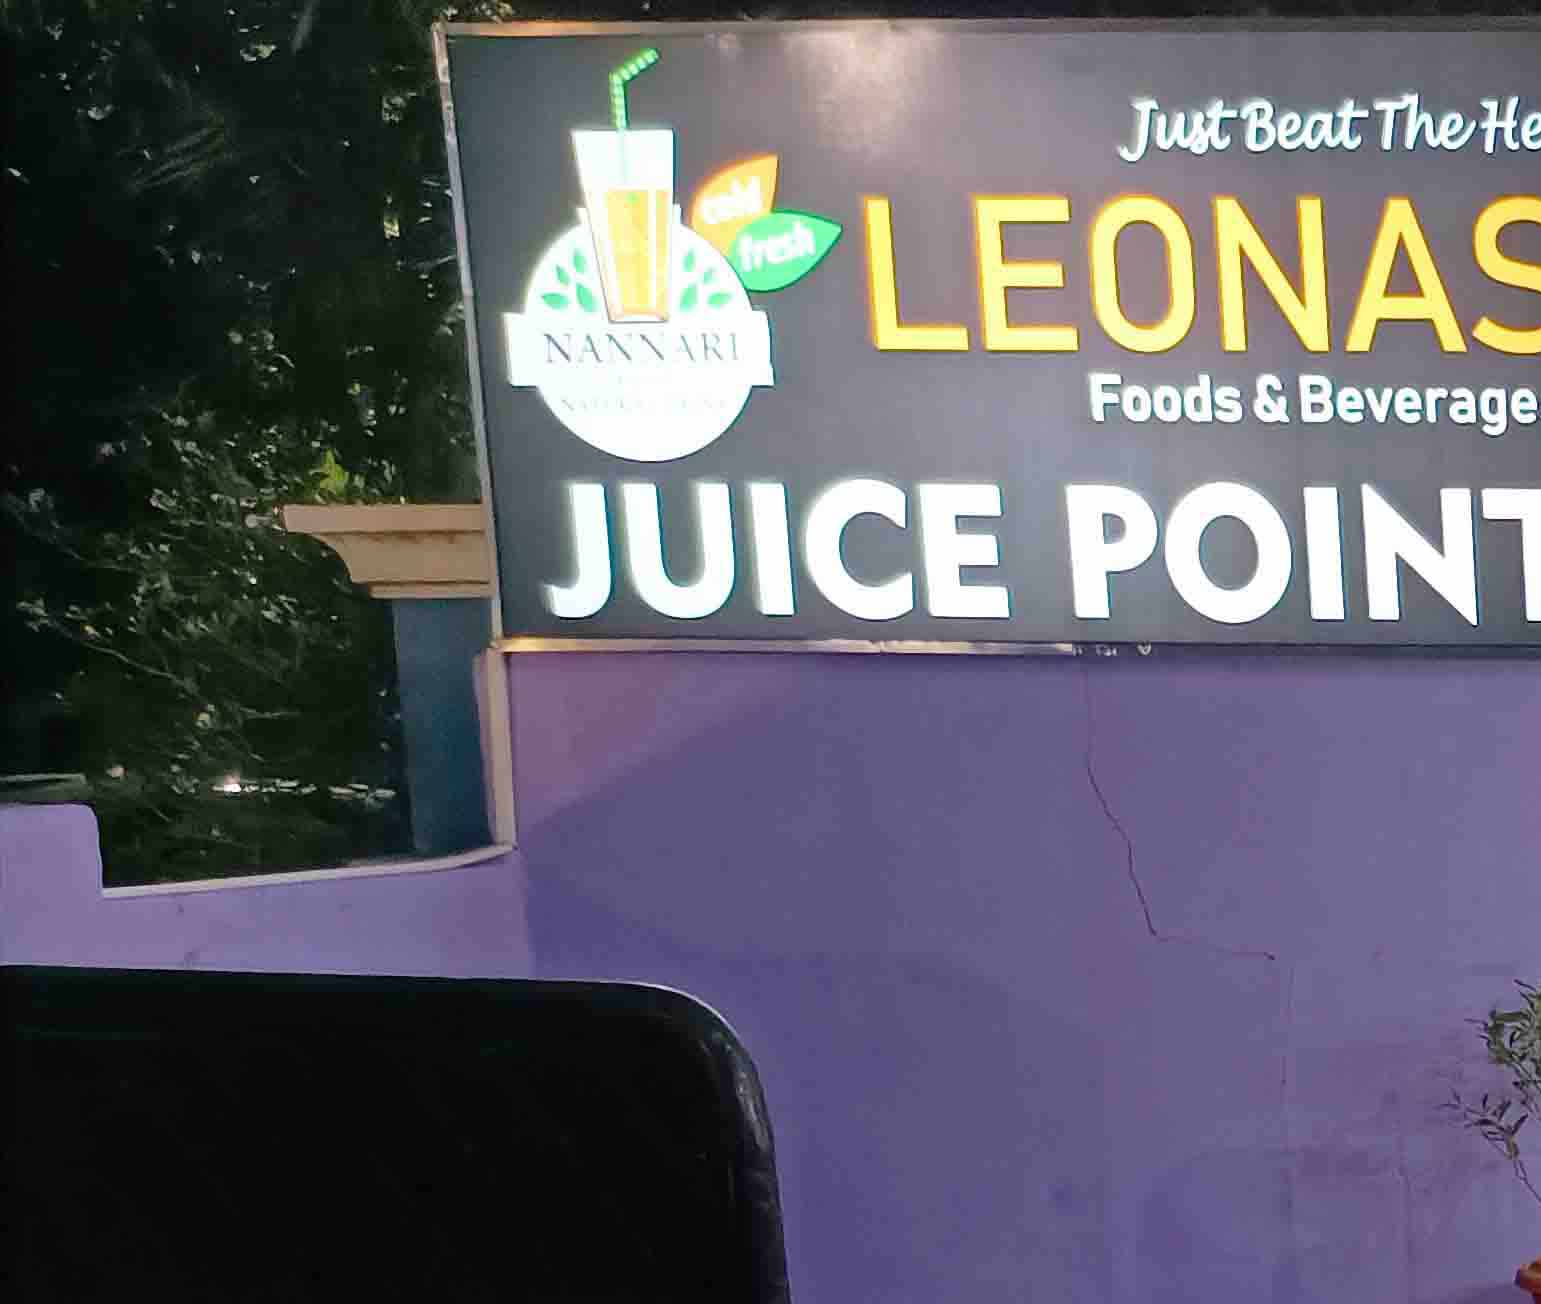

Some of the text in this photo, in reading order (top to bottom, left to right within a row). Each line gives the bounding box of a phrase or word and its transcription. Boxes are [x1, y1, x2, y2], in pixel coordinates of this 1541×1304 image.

[1117, 97, 1237, 163] Just
[1239, 97, 1370, 152] Beat
[1373, 92, 1477, 152] The
[1088, 373, 1243, 424] Foods
[1254, 373, 1290, 424] &
[546, 478, 1012, 622] JUICE
